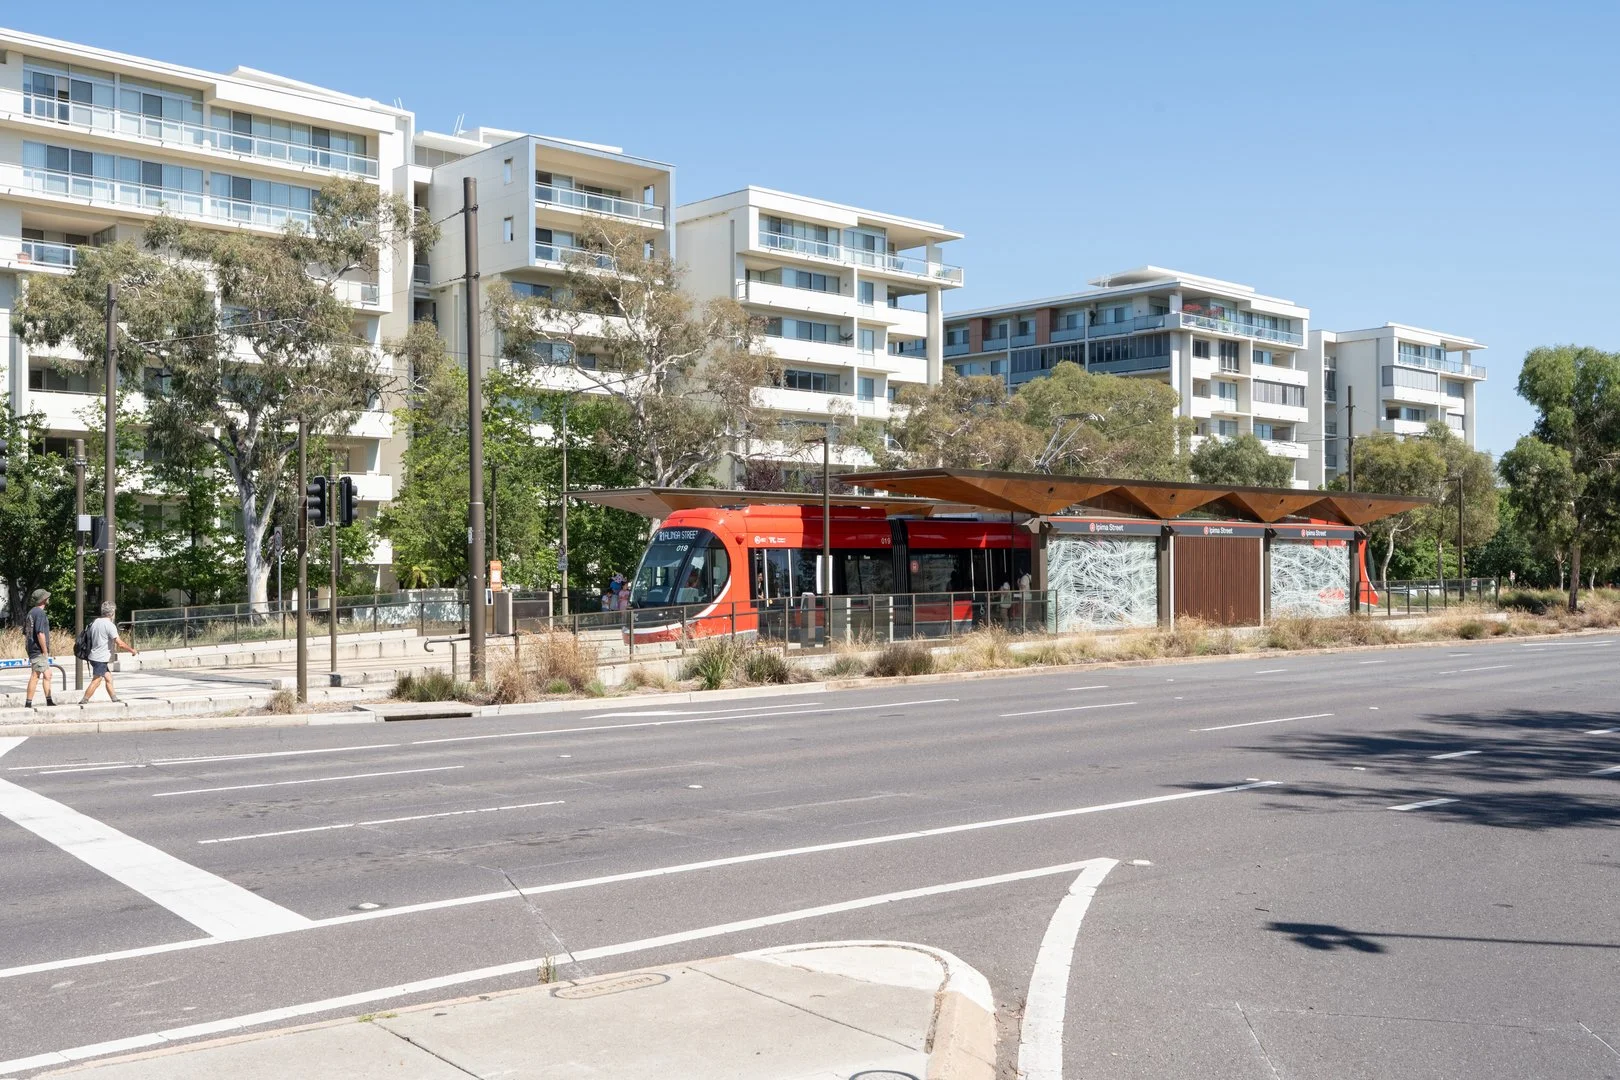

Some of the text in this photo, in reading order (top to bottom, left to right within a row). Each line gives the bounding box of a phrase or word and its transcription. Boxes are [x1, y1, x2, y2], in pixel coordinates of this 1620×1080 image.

[1096, 524, 1108, 532] Ipima
[1209, 526, 1220, 534] Ipima
[665, 531, 680, 540] ALINGA
[682, 530, 698, 539] STREET
